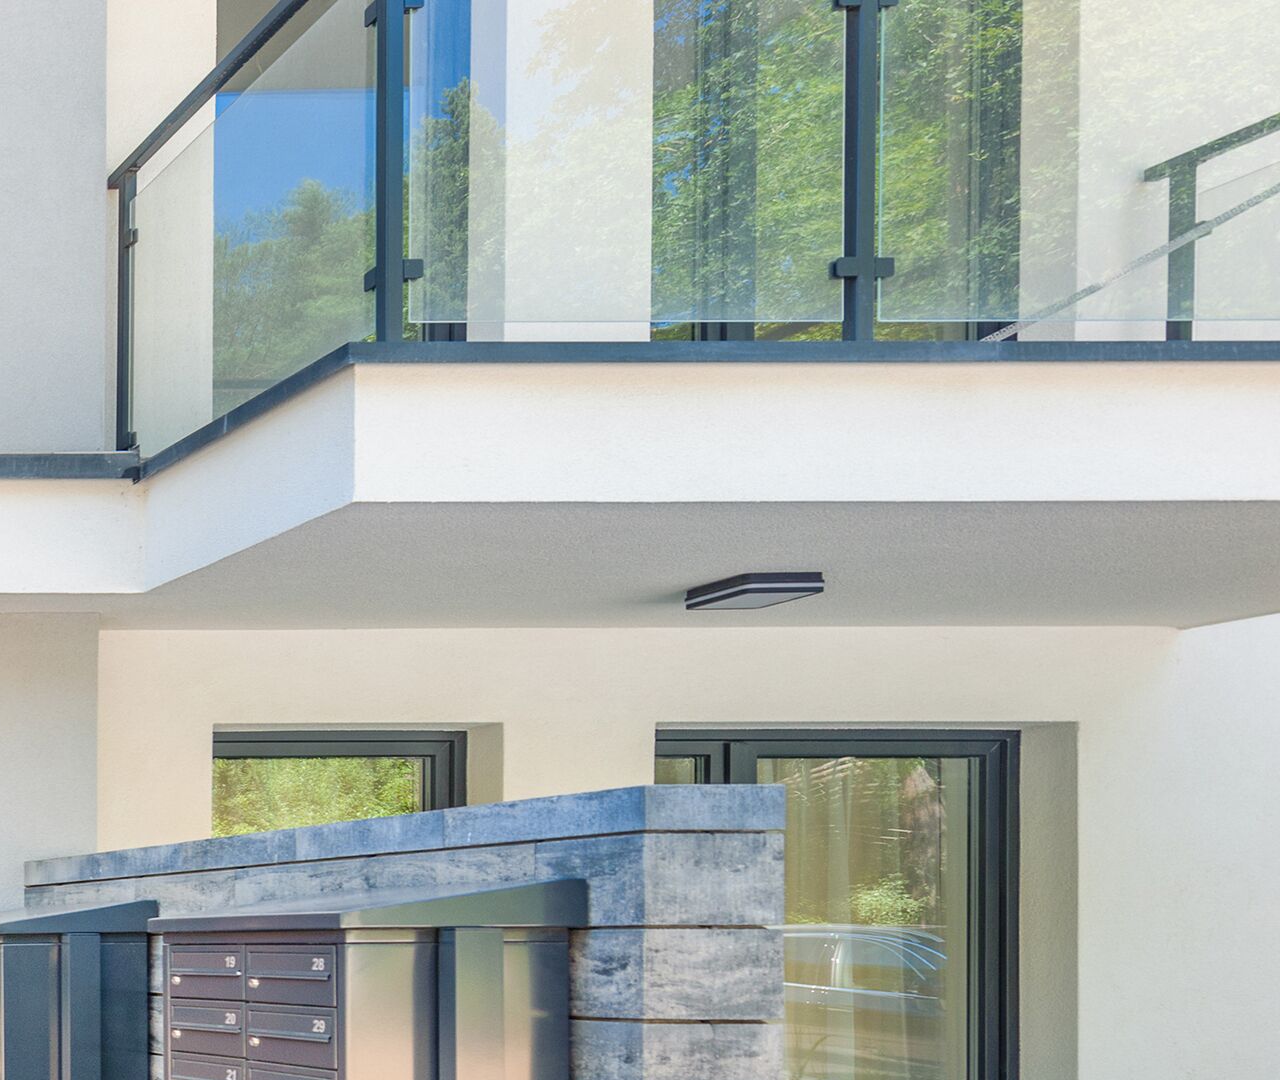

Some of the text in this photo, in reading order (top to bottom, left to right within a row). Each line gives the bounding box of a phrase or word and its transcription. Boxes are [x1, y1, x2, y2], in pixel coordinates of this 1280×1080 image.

[224, 956, 236, 968] 19
[311, 957, 325, 970] 28
[225, 1013, 237, 1025] 20
[312, 1020, 326, 1033] 29
